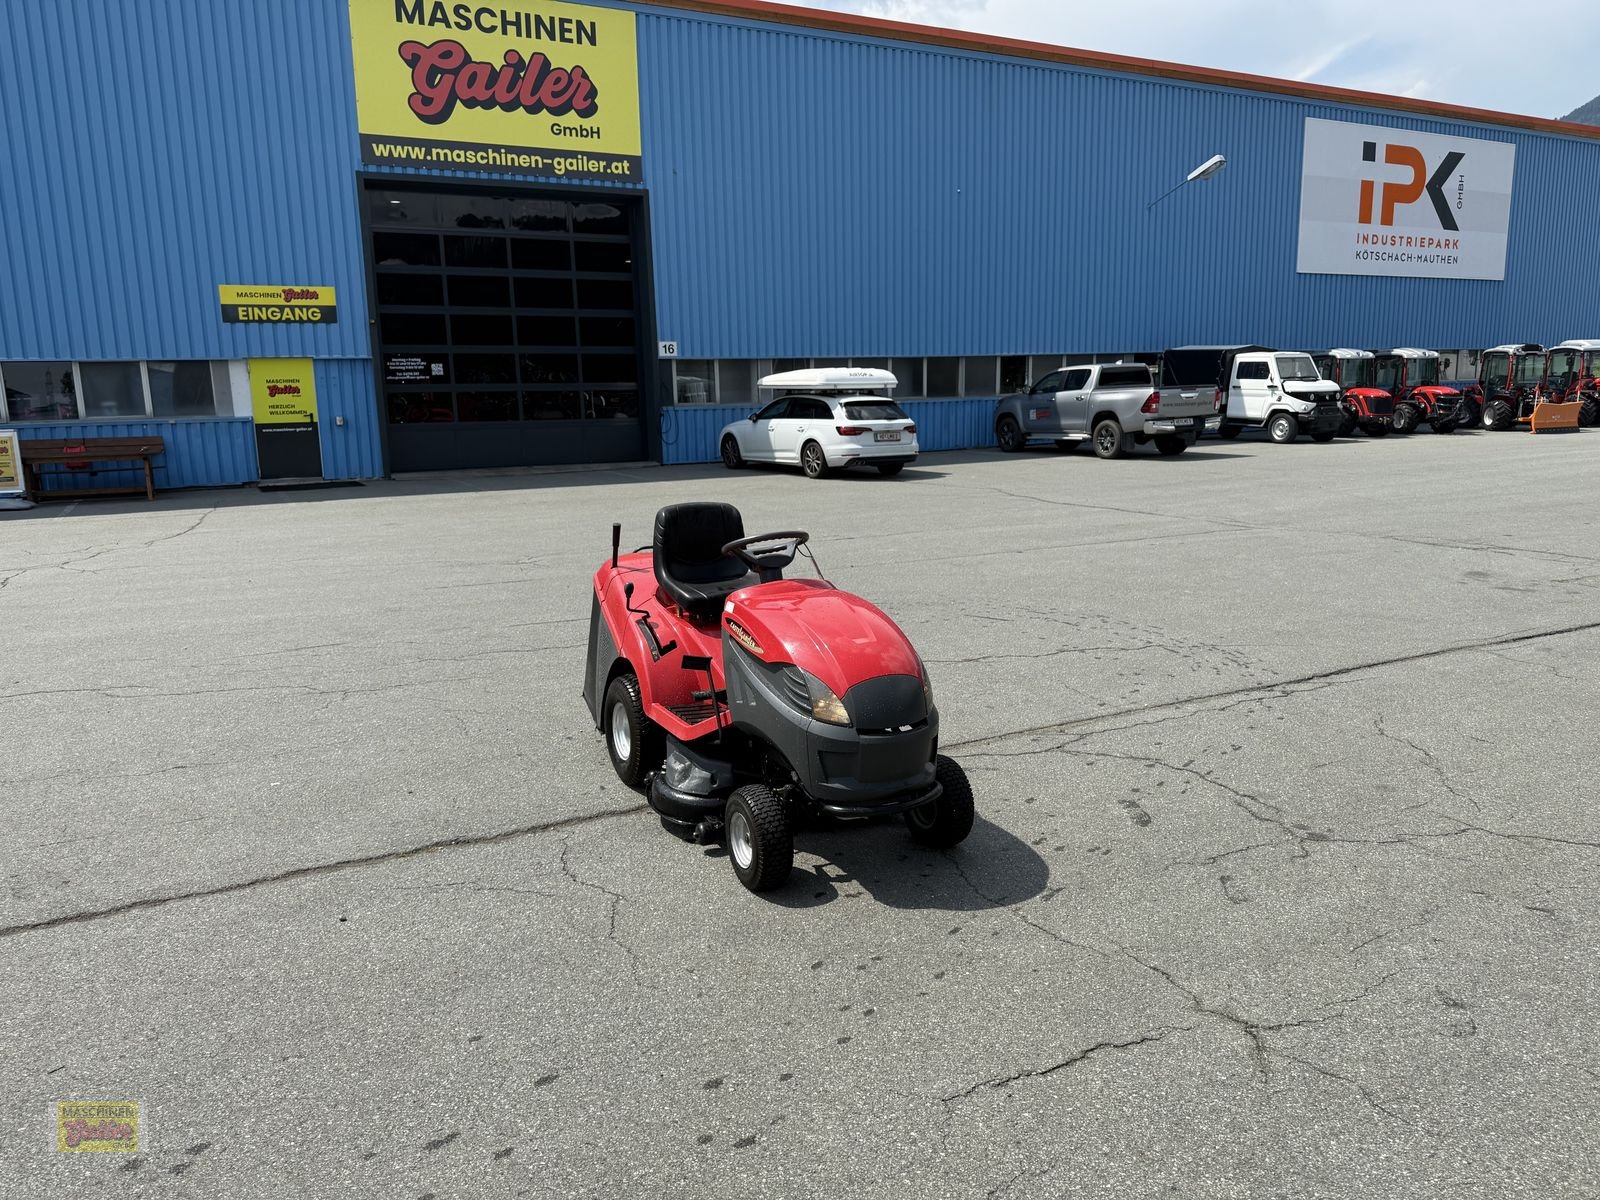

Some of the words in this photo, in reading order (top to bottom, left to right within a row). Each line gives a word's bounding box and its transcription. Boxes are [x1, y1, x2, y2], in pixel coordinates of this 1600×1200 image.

[395, 0, 597, 47] MASCHINEN
[398, 39, 598, 125] Gailer
[550, 122, 601, 140] GmbH
[372, 141, 631, 175] www.maschinen-gailer.at
[1356, 233, 1459, 249] INDUSTRIEPARK
[1355, 250, 1458, 265] KÖTSCHACH-MAUTHEN
[236, 291, 282, 299] MASCHINEN
[281, 288, 319, 303] Gailer
[237, 306, 322, 321] EINGANG
[662, 343, 675, 355] 16
[266, 384, 301, 398] Gailer
